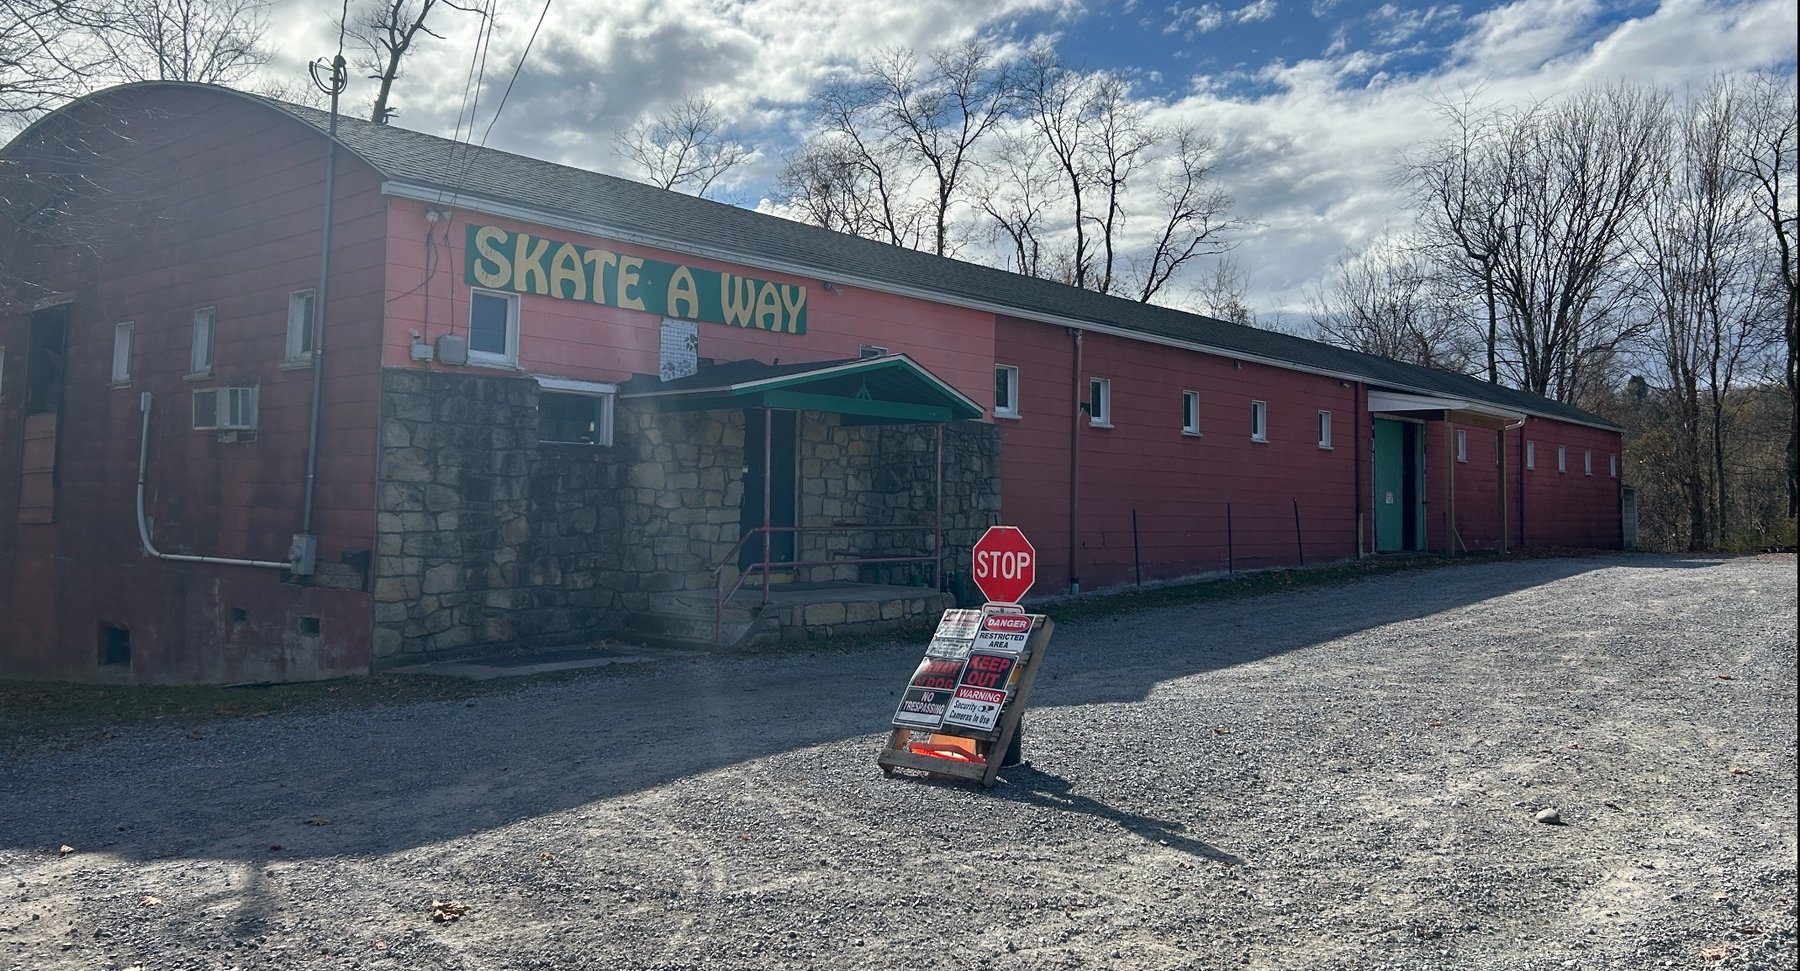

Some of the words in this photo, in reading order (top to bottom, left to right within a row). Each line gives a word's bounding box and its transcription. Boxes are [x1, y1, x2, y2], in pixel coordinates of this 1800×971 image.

[474, 226, 645, 311] SKATE
[667, 265, 698, 318] A
[720, 272, 806, 333] WAY
[977, 551, 1031, 579] STOP
[987, 619, 1028, 628] DANGER
[980, 632, 1024, 641] RESTRICTED
[968, 655, 1011, 672] KEEP
[926, 677, 953, 688] DOG
[967, 670, 1000, 687] OUT
[921, 691, 935, 702] NO
[959, 689, 1001, 702] WARNING
[903, 701, 945, 715] TRESPASSING
[954, 700, 977, 712] Security
[949, 710, 972, 721] Cameras
[979, 714, 990, 724] Use
